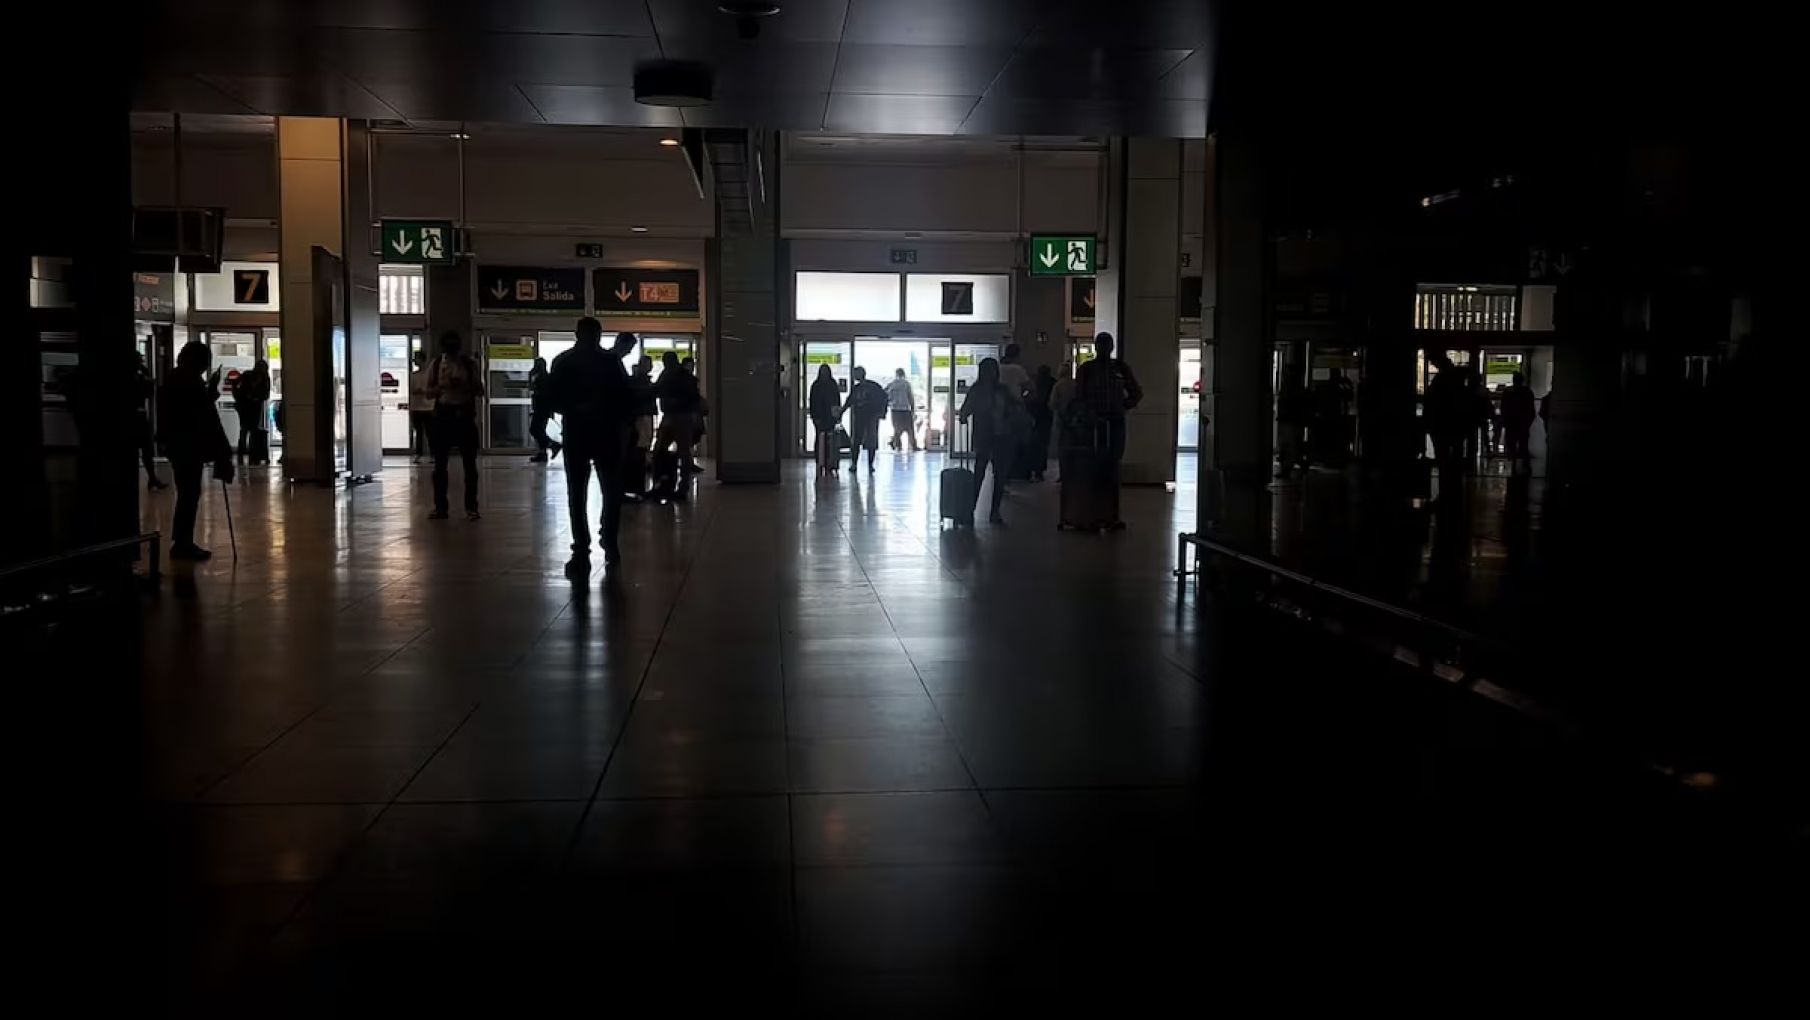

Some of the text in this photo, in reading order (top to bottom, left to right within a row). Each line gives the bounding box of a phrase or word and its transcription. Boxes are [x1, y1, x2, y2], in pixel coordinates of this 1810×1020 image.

[241, 272, 260, 301] 7
[543, 291, 575, 301] Salida
[948, 285, 966, 312] 7
